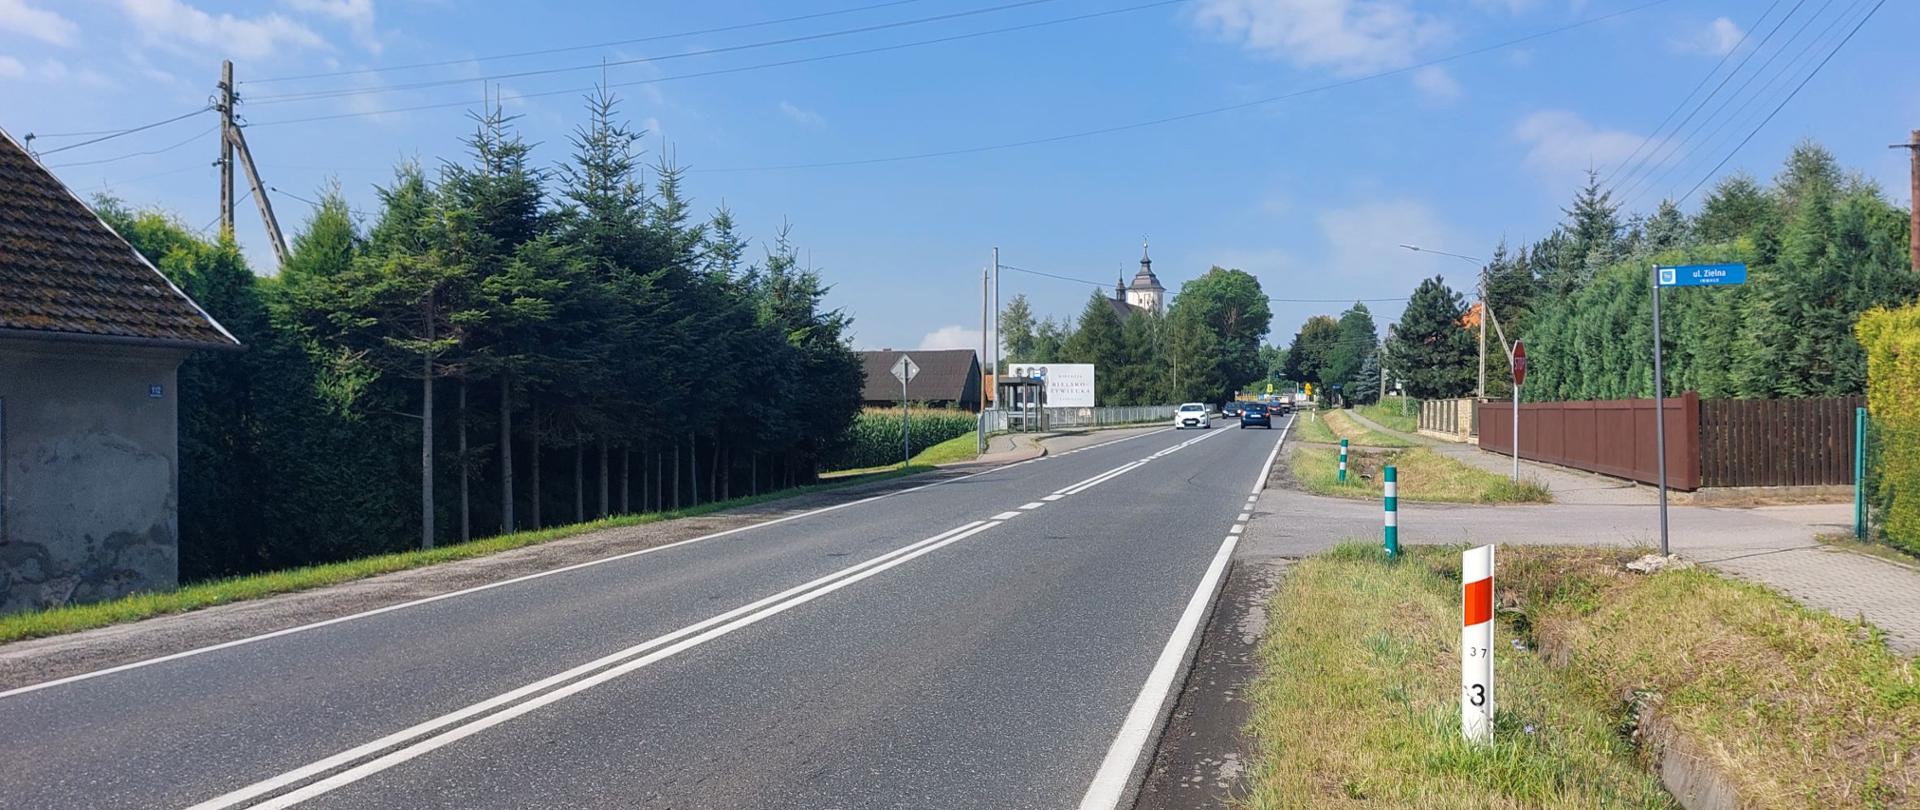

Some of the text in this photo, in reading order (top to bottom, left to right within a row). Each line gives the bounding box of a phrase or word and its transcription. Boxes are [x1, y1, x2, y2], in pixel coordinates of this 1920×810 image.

[1692, 268, 1727, 278] ul. Zielna
[1514, 357, 1525, 370] STOP
[1470, 683, 1485, 707] 3
